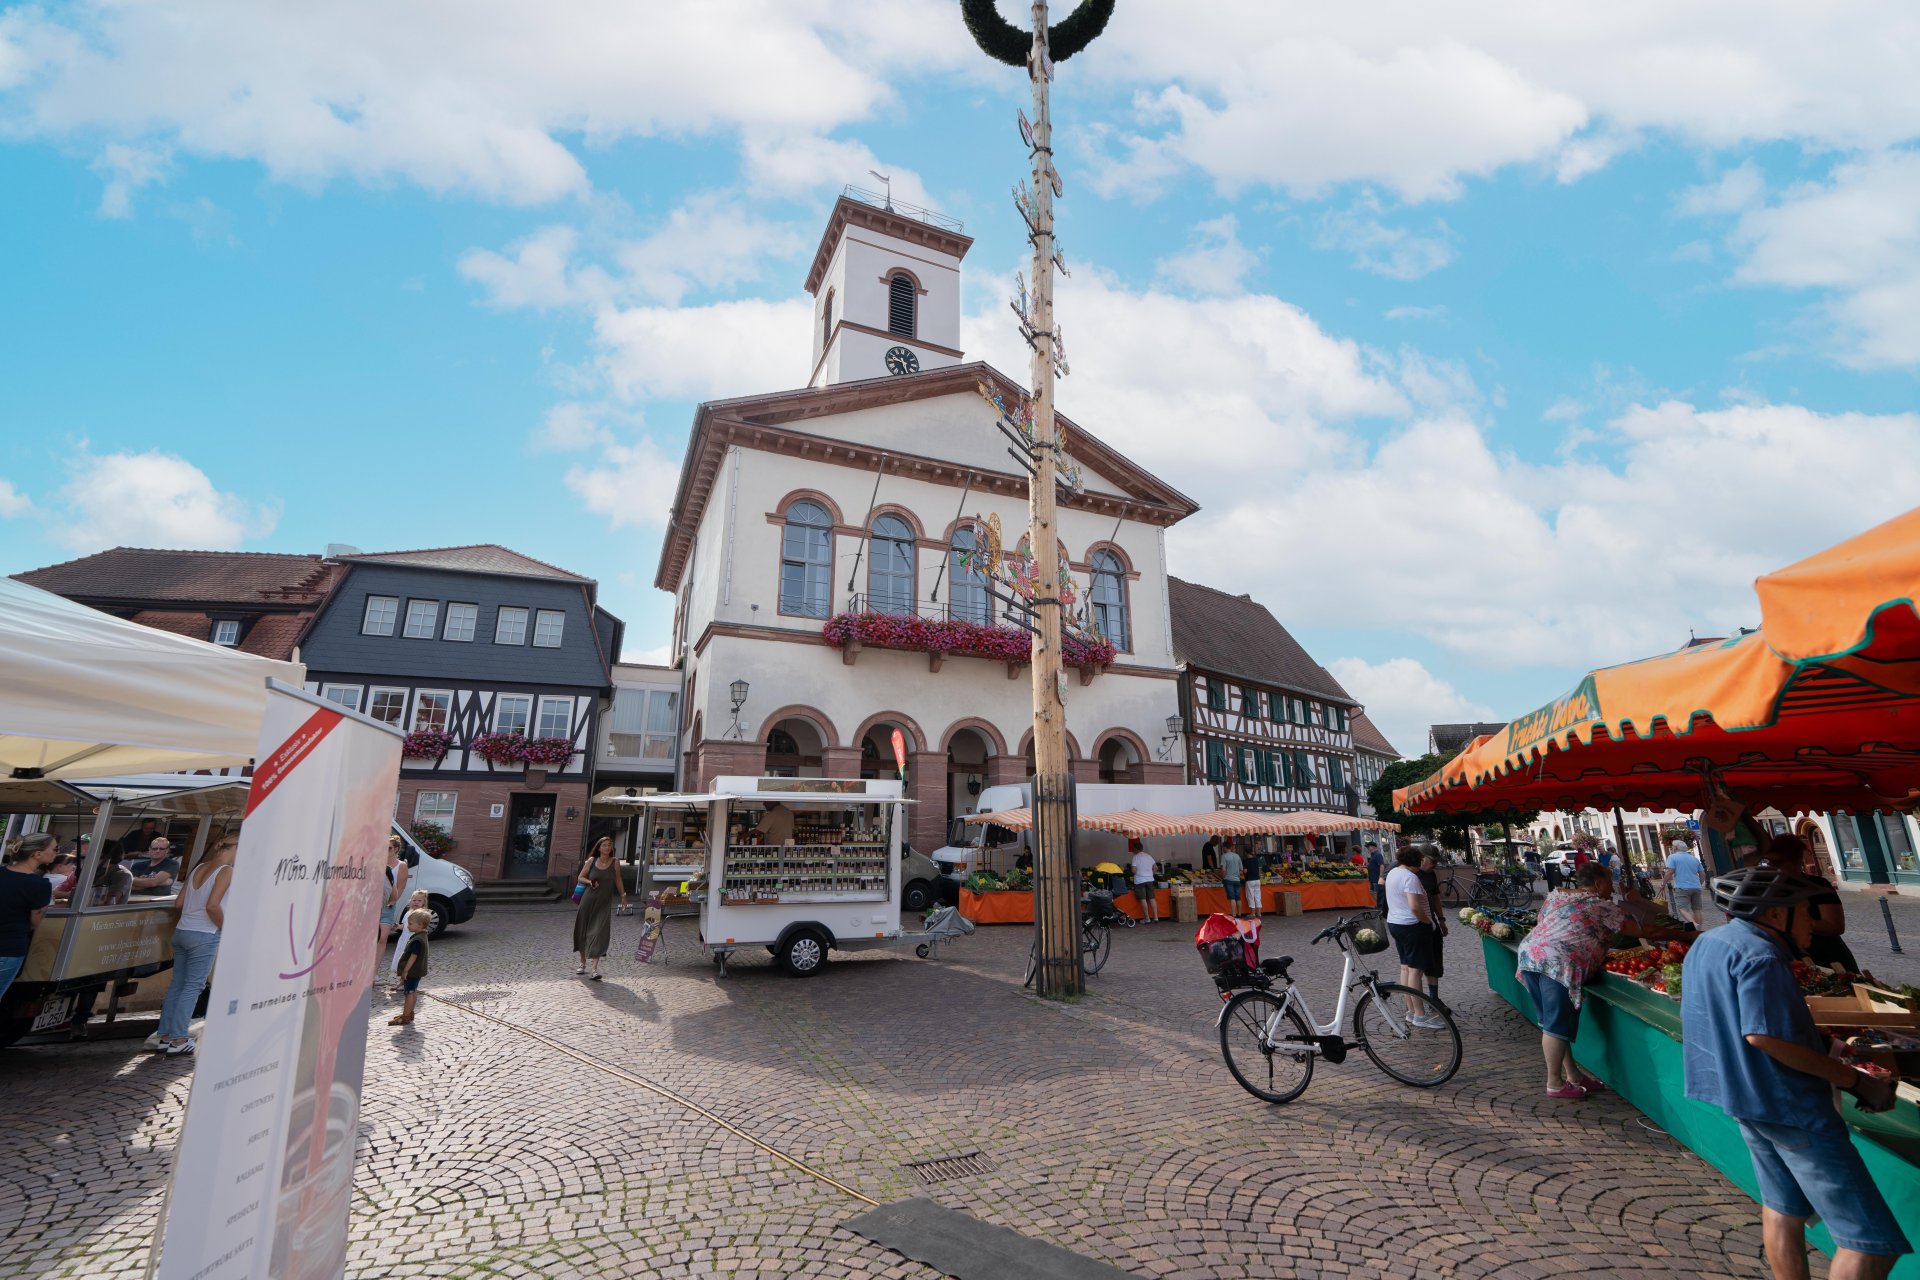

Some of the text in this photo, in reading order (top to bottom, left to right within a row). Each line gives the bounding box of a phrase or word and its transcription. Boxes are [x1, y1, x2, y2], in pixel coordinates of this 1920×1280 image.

[1688, 820, 1697, 829] P
[250, 993, 297, 1011] marmelade
[329, 982, 335, 991] &
[336, 979, 353, 989] more
